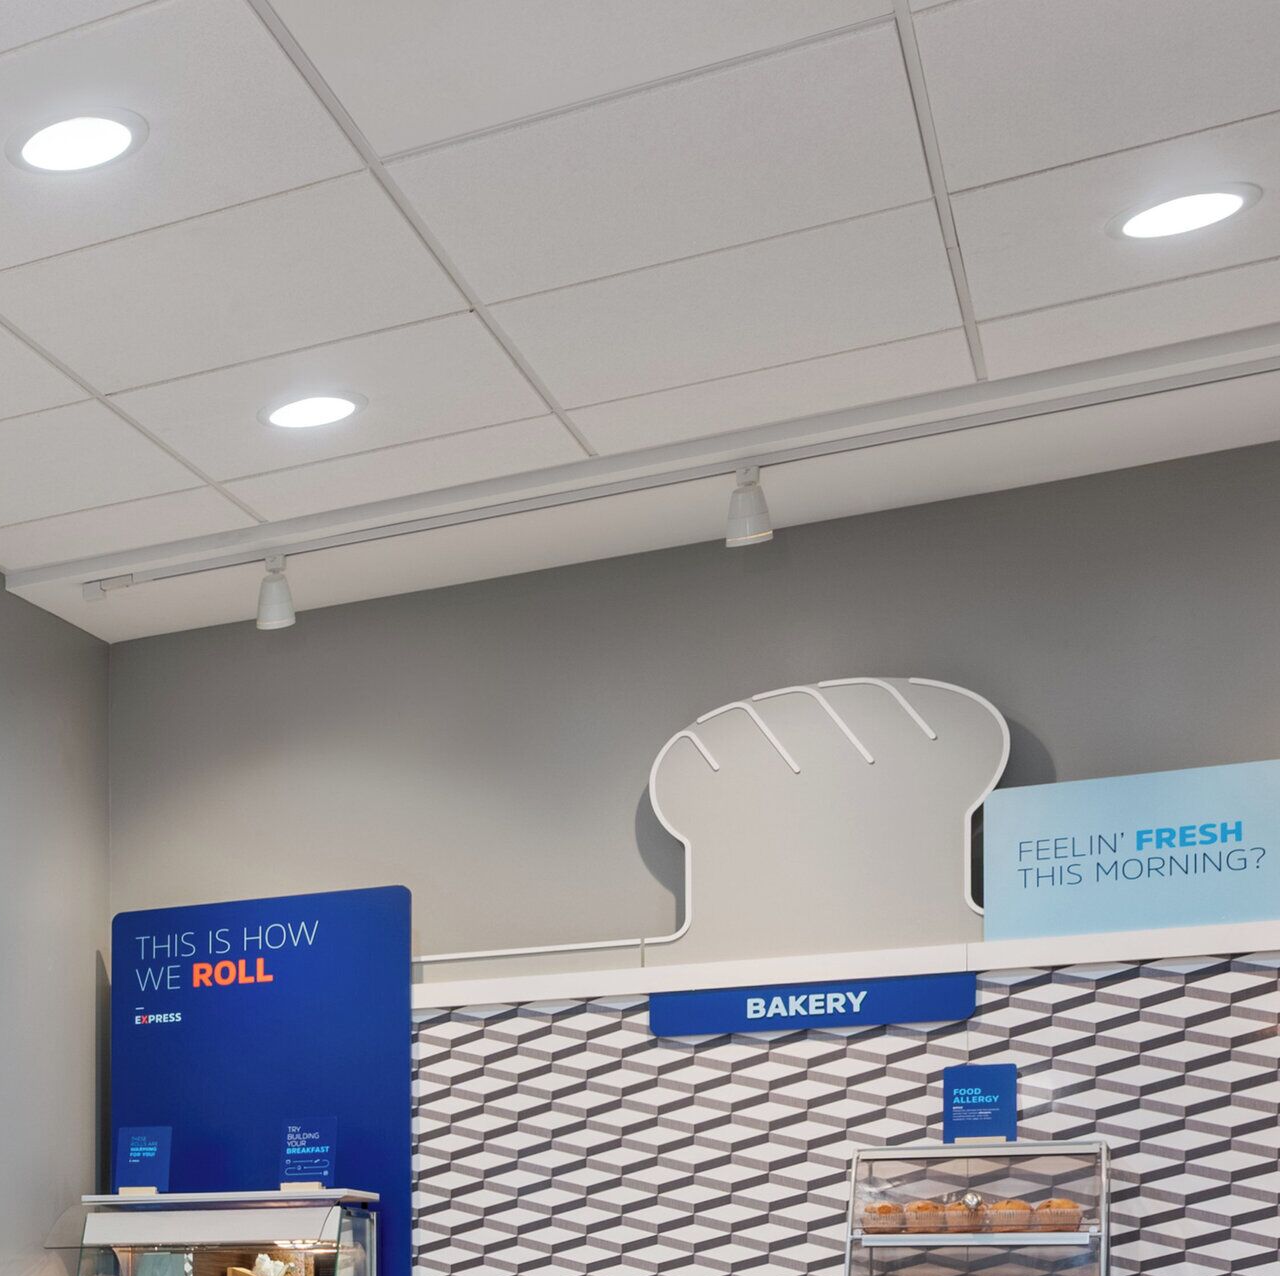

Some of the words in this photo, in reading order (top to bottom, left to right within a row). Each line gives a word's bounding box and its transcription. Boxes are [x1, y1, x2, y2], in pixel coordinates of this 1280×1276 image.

[1136, 821, 1243, 852] FRESH
[1018, 863, 1083, 889] THIS
[1096, 847, 1266, 883] MORNING?
[135, 931, 196, 960] THIS
[209, 928, 231, 955] IS
[244, 920, 319, 951] HOW
[135, 965, 181, 992] WE
[192, 957, 274, 988] ROLL
[746, 991, 867, 1020] BAKERY
[134, 1012, 182, 1025] EXPRESS
[953, 1088, 982, 1096] FOOD
[953, 1095, 1000, 1104] ALLERGY
[287, 1132, 320, 1141] BUILDING
[286, 1145, 330, 1155] BREAKFAST
